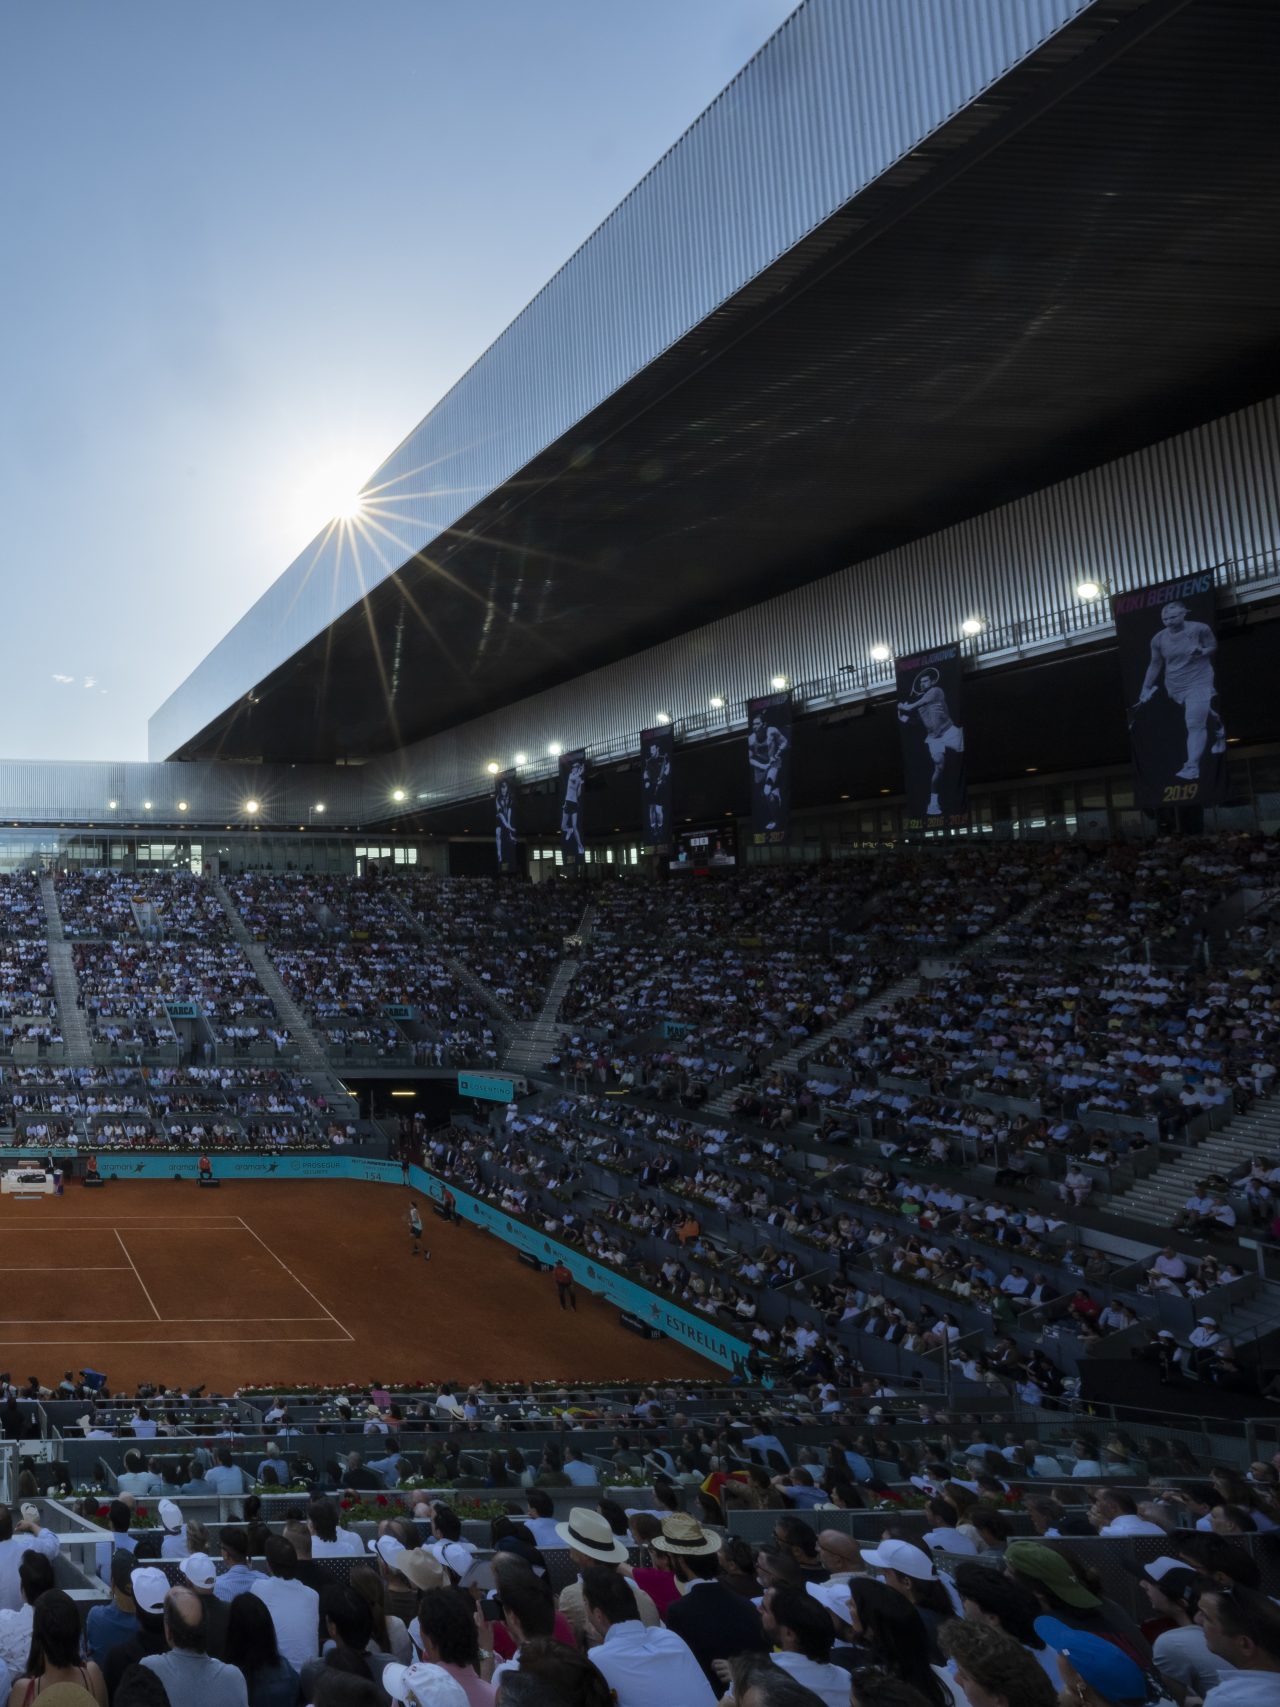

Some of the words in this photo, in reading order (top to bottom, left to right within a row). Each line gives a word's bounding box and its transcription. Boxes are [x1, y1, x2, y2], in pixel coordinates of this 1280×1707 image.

[1115, 594, 1145, 614] KIKI
[1146, 574, 1211, 607] BERTENS
[1162, 783, 1199, 802] 2019
[167, 1005, 194, 1015] MARCA
[101, 1163, 133, 1172] aramark
[234, 1163, 267, 1171] aramark
[365, 1171, 381, 1180] 154
[666, 1314, 728, 1359] ESTRELLA
